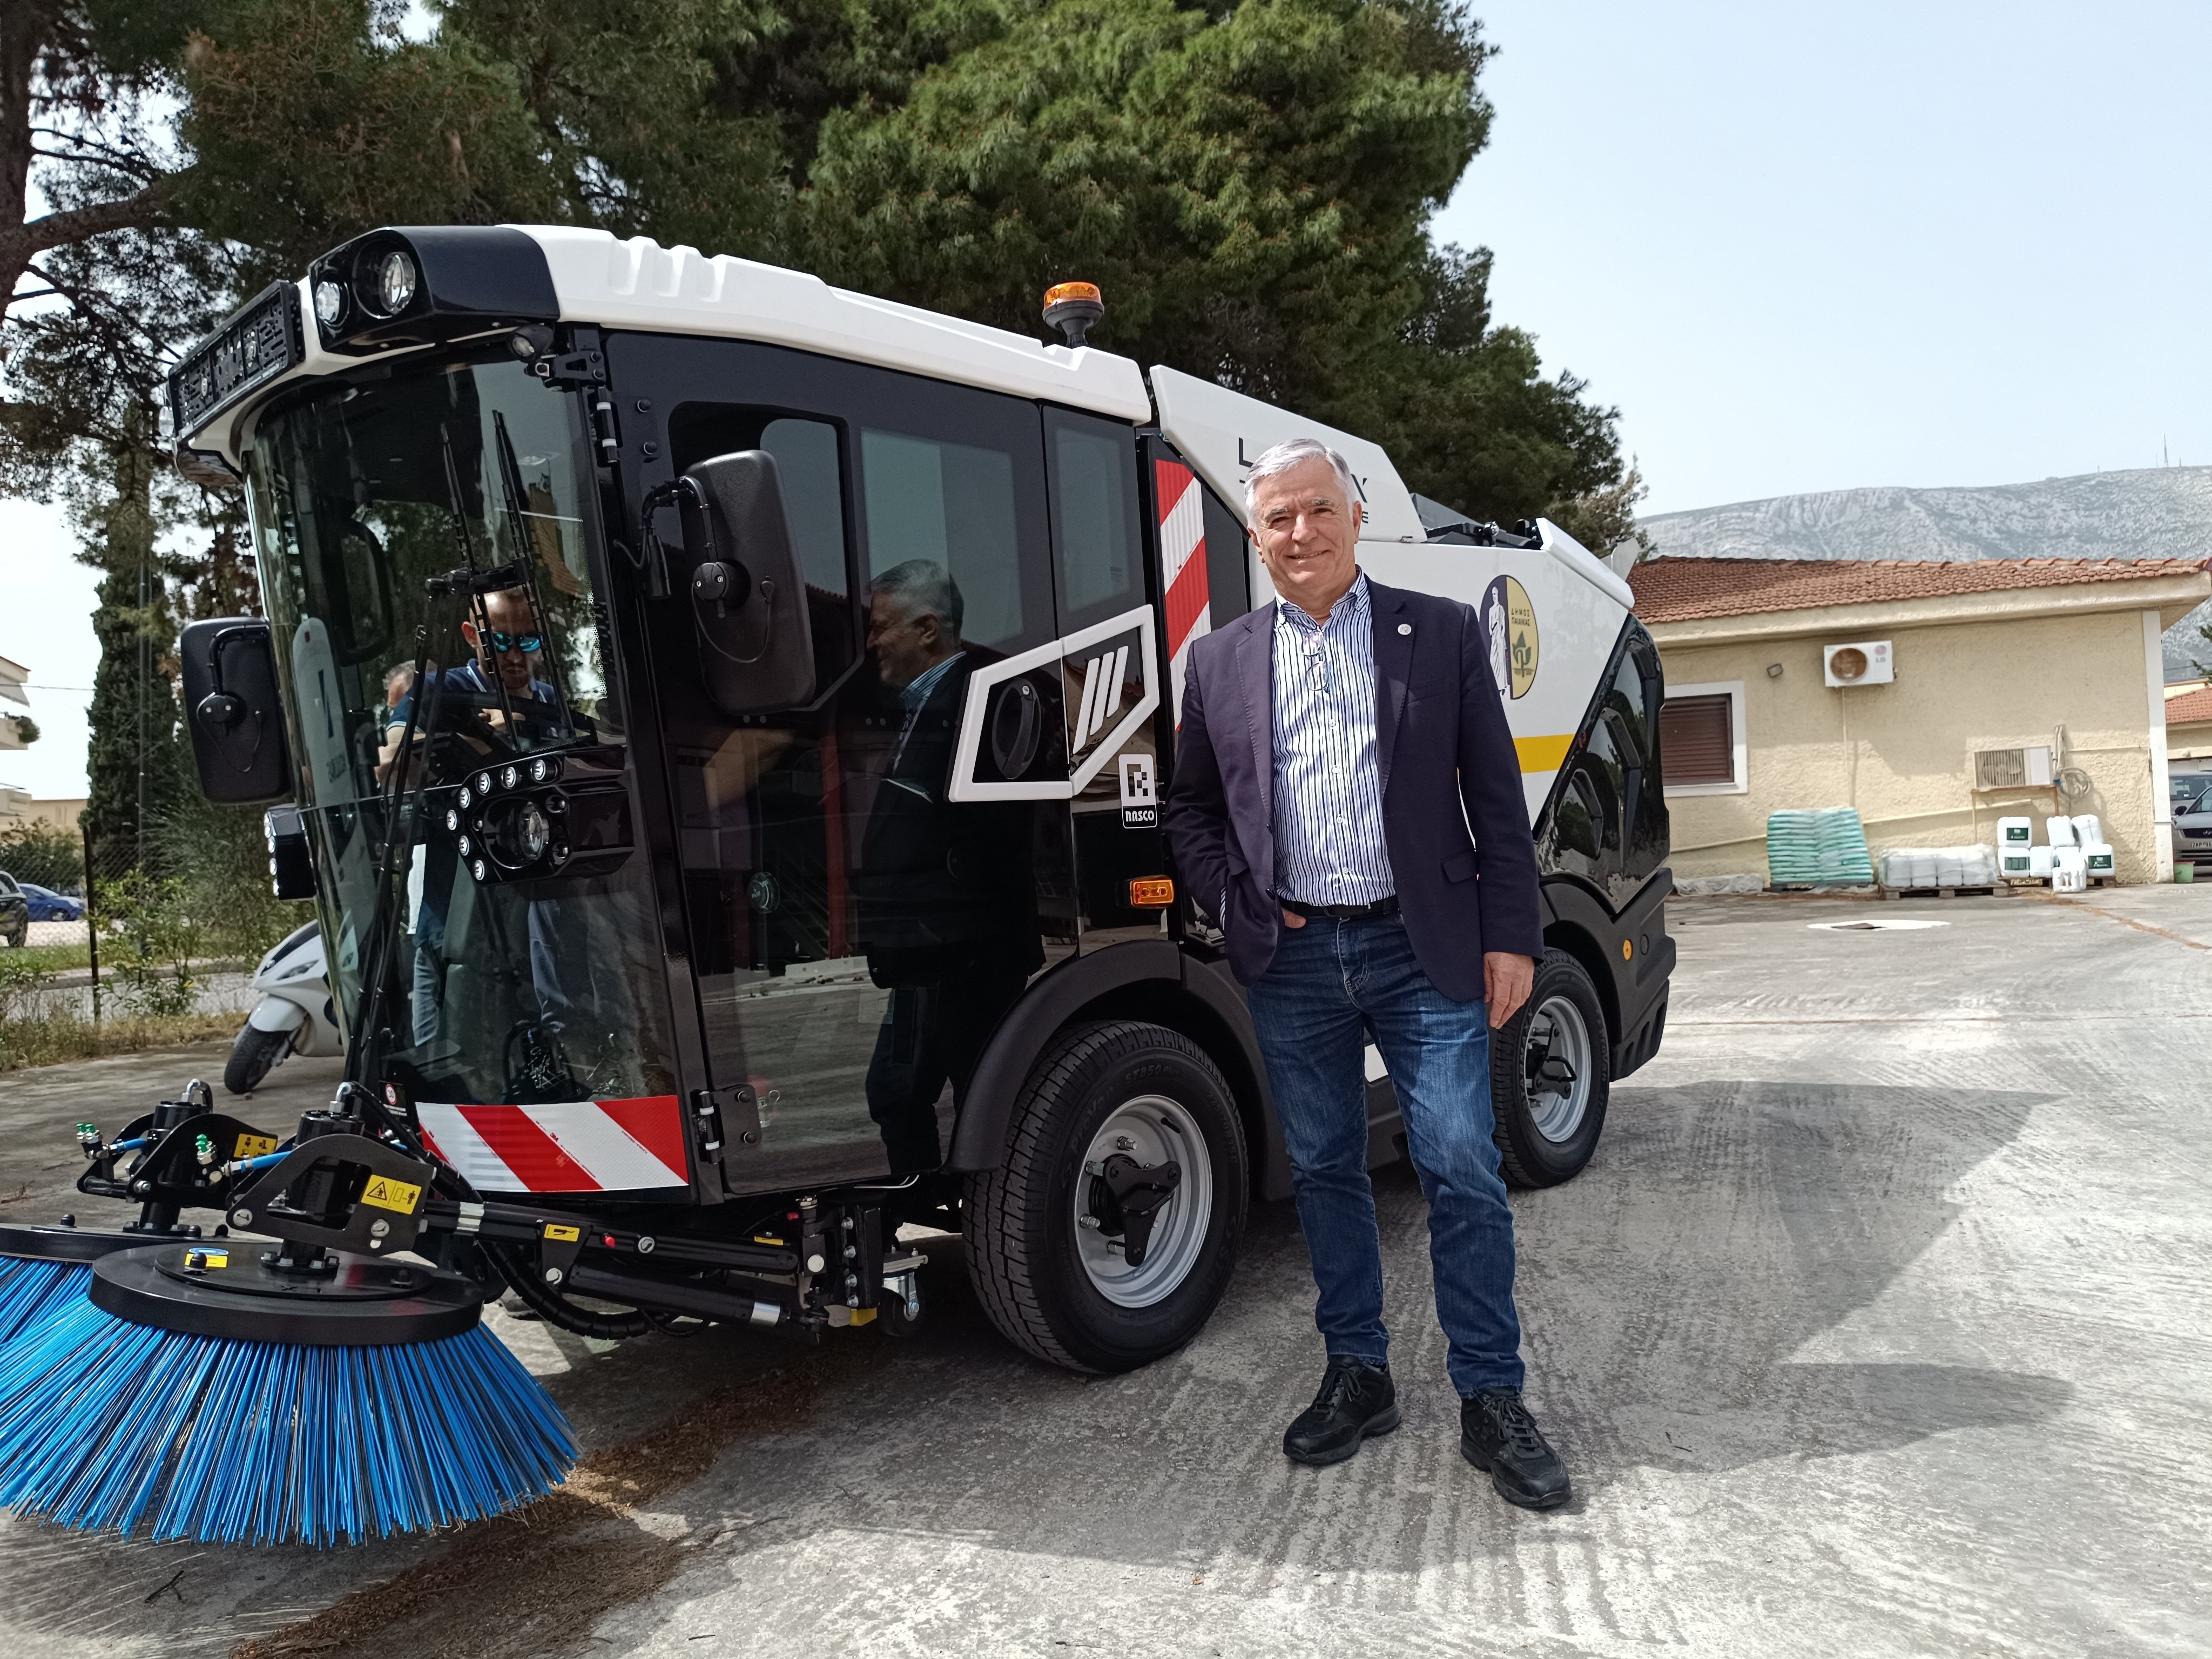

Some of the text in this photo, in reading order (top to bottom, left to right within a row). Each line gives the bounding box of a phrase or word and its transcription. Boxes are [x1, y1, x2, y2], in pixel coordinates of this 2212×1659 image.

[1511, 608, 1530, 617] ΔΗΜΟΣ
[1125, 811, 1155, 822] RASCO
[1125, 1064, 1162, 1084] ST850
[550, 1132, 559, 1142] 3M
